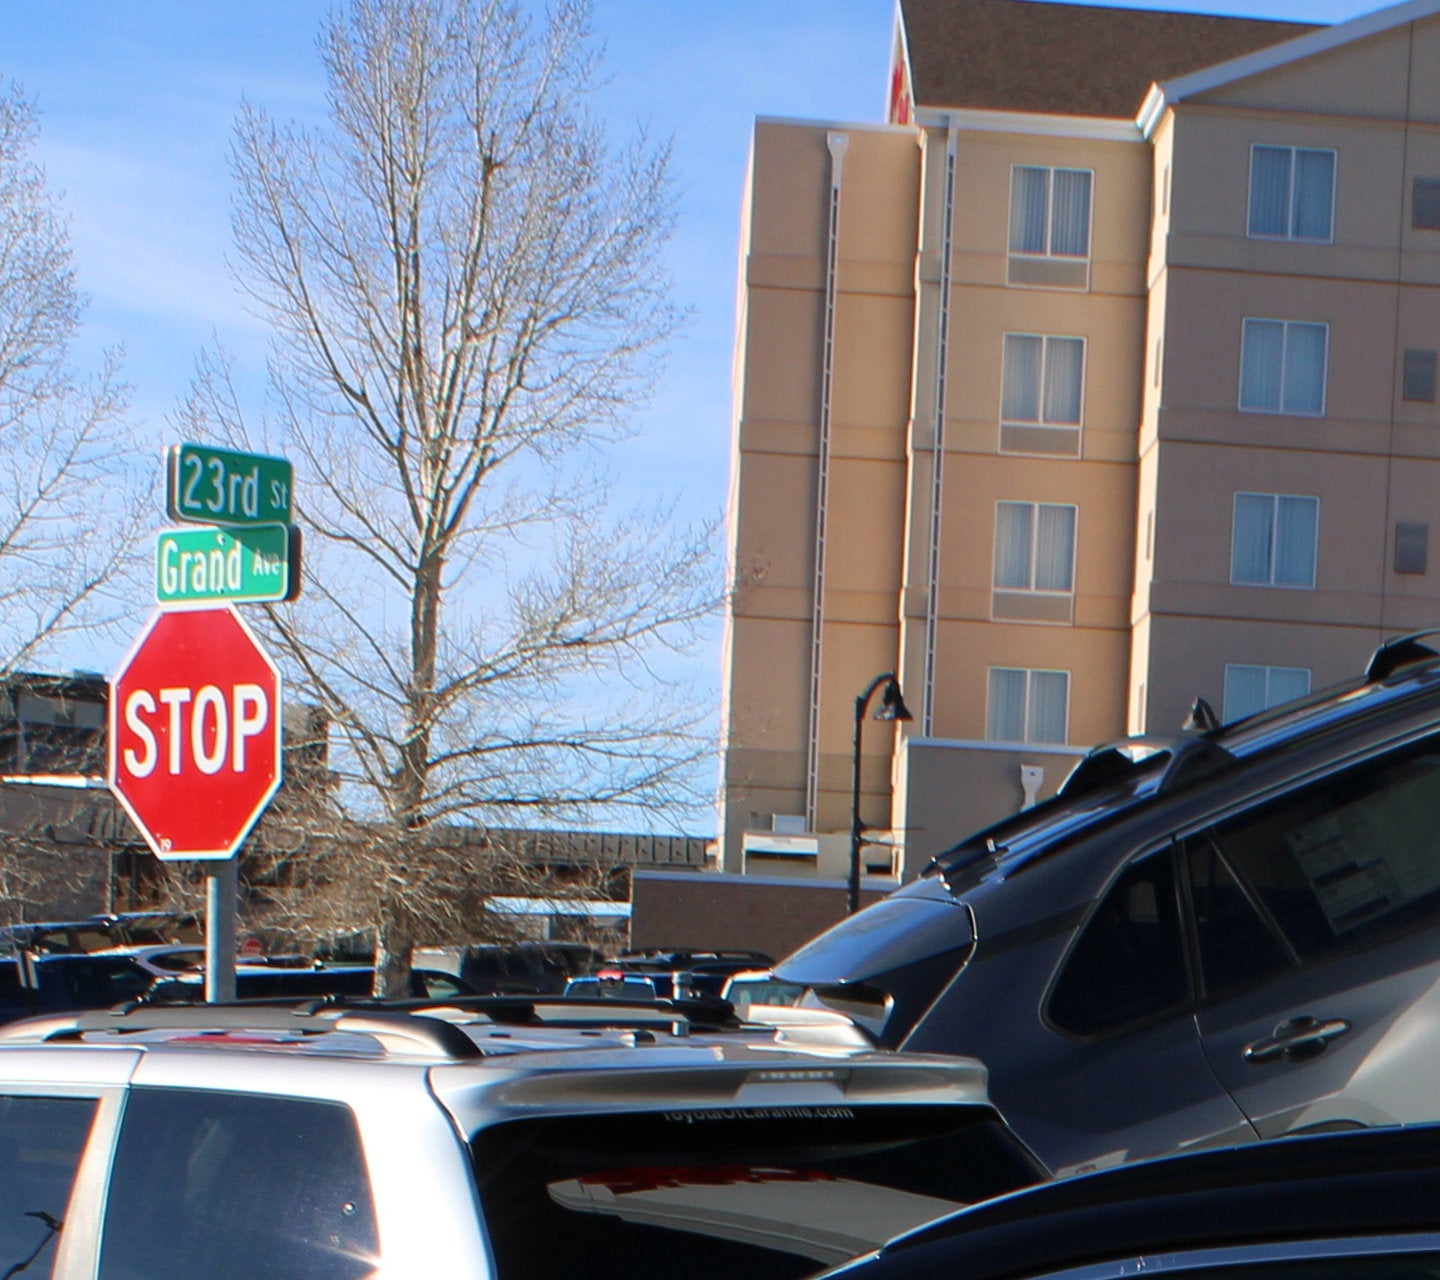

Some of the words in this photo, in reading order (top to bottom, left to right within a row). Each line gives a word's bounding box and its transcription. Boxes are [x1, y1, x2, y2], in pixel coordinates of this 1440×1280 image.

[183, 453, 259, 519] 23rd
[270, 480, 288, 510] St
[162, 538, 242, 595] Grand
[252, 547, 281, 577] Ave
[123, 685, 268, 778] STOP
